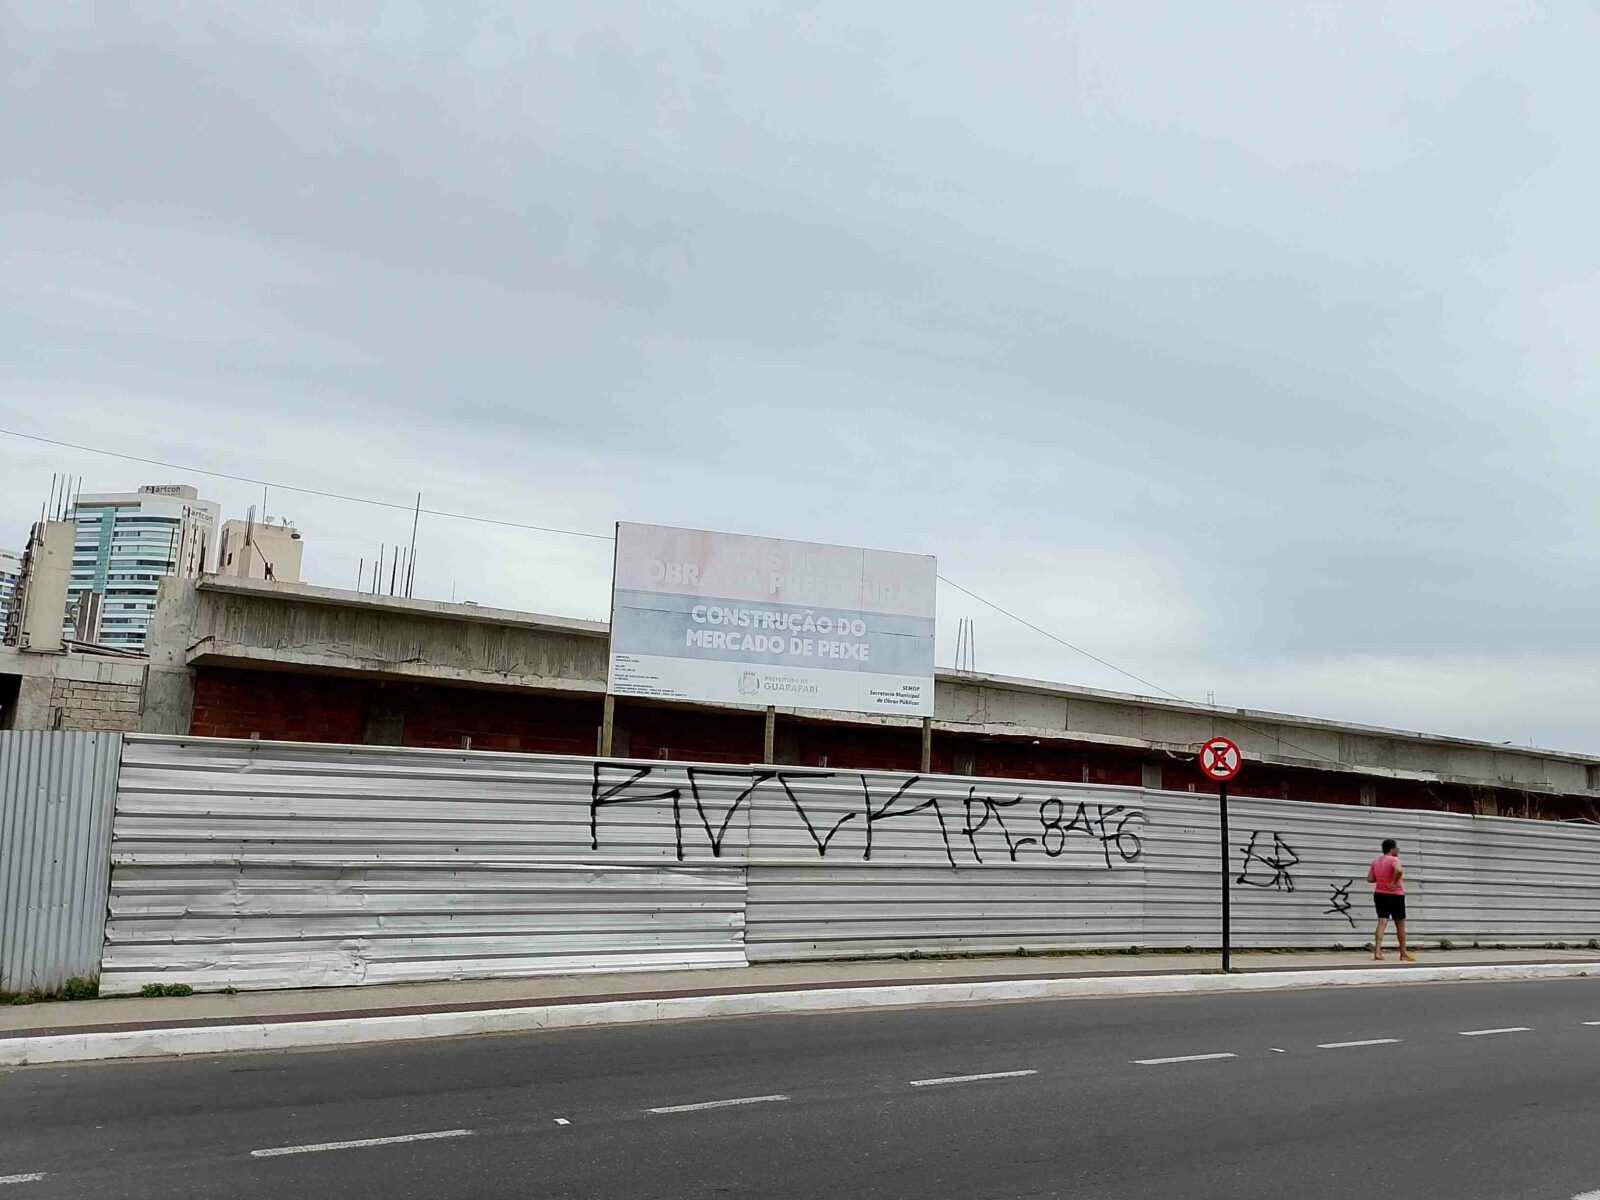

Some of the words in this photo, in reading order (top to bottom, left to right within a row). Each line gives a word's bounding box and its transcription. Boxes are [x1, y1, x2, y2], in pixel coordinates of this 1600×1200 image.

[191, 510, 213, 522] artcon
[648, 559, 716, 588] OBRA
[691, 604, 833, 636] CONSTRUÇÃO
[837, 618, 867, 637] DO
[686, 628, 785, 654] MERCADO
[789, 638, 813, 657] DE
[817, 640, 869, 661] PEIXE
[764, 676, 799, 684] PREFEITURA
[764, 682, 818, 694] GUARAPARI
